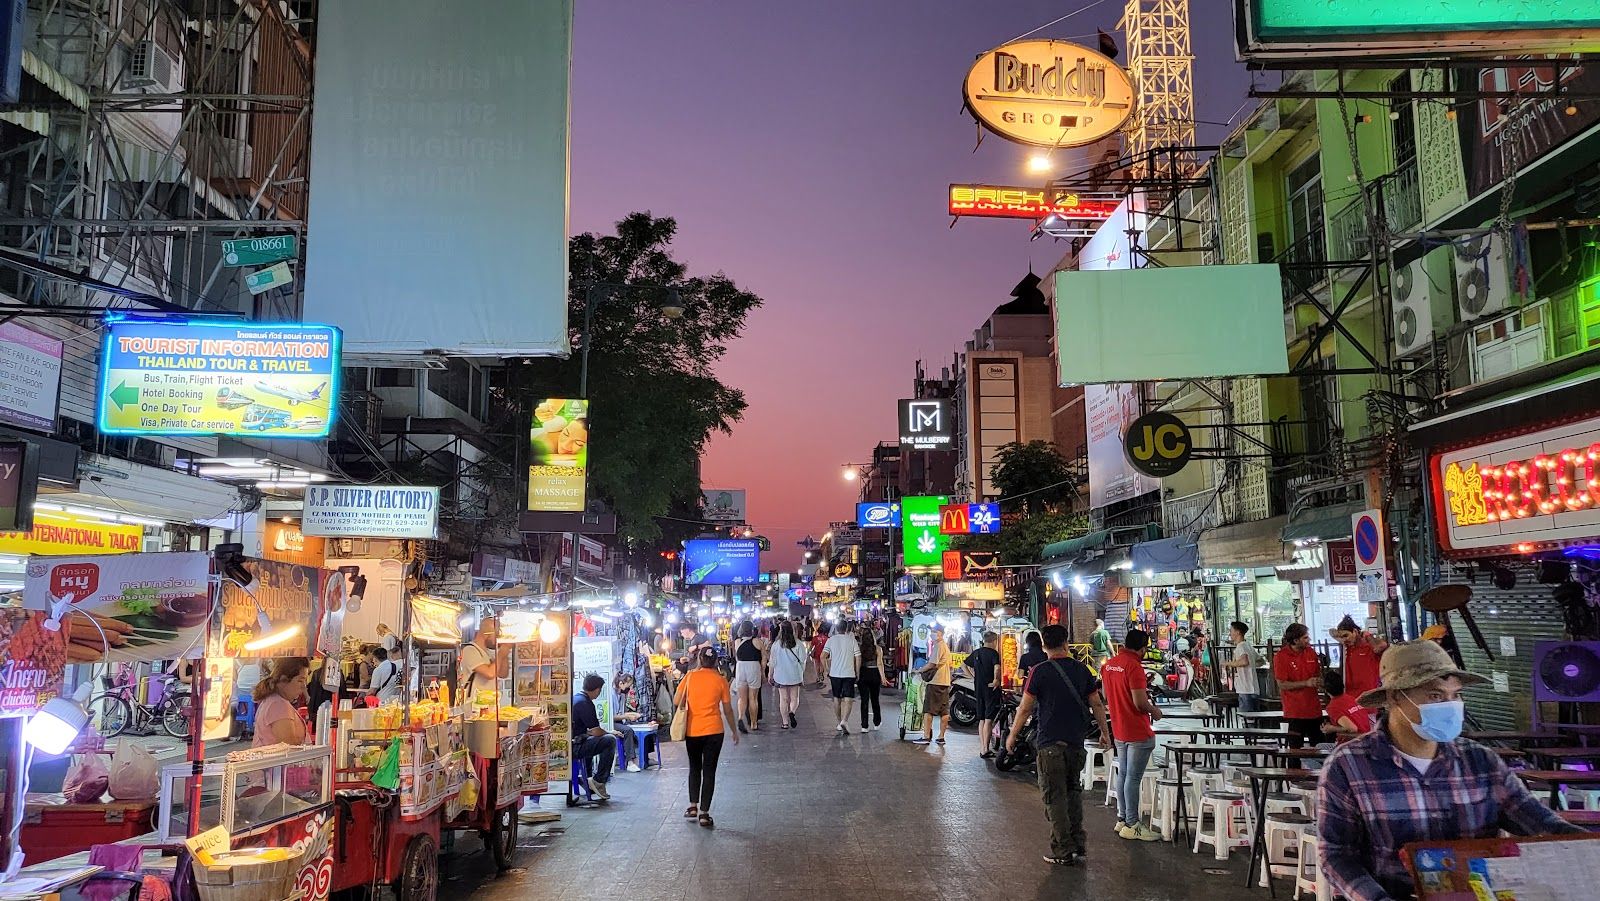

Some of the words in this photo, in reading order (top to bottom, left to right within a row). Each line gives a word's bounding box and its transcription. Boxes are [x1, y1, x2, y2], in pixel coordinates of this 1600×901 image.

[994, 52, 1105, 107] Buddy
[1002, 111, 1094, 128] GROP
[952, 188, 1045, 204] BRICK
[251, 237, 287, 251] 018661
[118, 338, 198, 355] TOURIST
[202, 341, 329, 358] INFORMATION
[12, 350, 25, 360] FAN
[42, 360, 59, 371] ROOM
[138, 356, 206, 369] THAILAND
[210, 358, 245, 370] TOUR
[249, 358, 258, 371] &
[261, 358, 312, 372] TRAVEL
[24, 365, 43, 378] CLEAN
[217, 374, 243, 385] Ticket
[14, 386, 39, 400] SERVICE
[142, 388, 165, 398] Hotel
[169, 388, 203, 400] Booking
[141, 403, 158, 412] One
[162, 403, 178, 414] Day
[182, 403, 202, 413] Tour
[140, 417, 188, 428] Visa,Private
[191, 419, 205, 429] Car
[207, 420, 234, 429] service
[900, 436, 914, 444] THE
[915, 436, 950, 444] MULBERRY
[1133, 424, 1186, 460] JC
[547, 477, 567, 485] relax
[310, 487, 330, 507] S.P.
[333, 488, 372, 508] SILVER
[374, 489, 433, 512] (FACTORY)
[534, 488, 580, 497] MASSAGE
[973, 511, 992, 525] 24
[324, 525, 411, 534] www.spsilverjewelry.com
[23, 524, 104, 548] INTERNATIONAL
[109, 532, 139, 550] TAILOR
[60, 575, 89, 589] หมู
[2, 690, 36, 706] chicken
